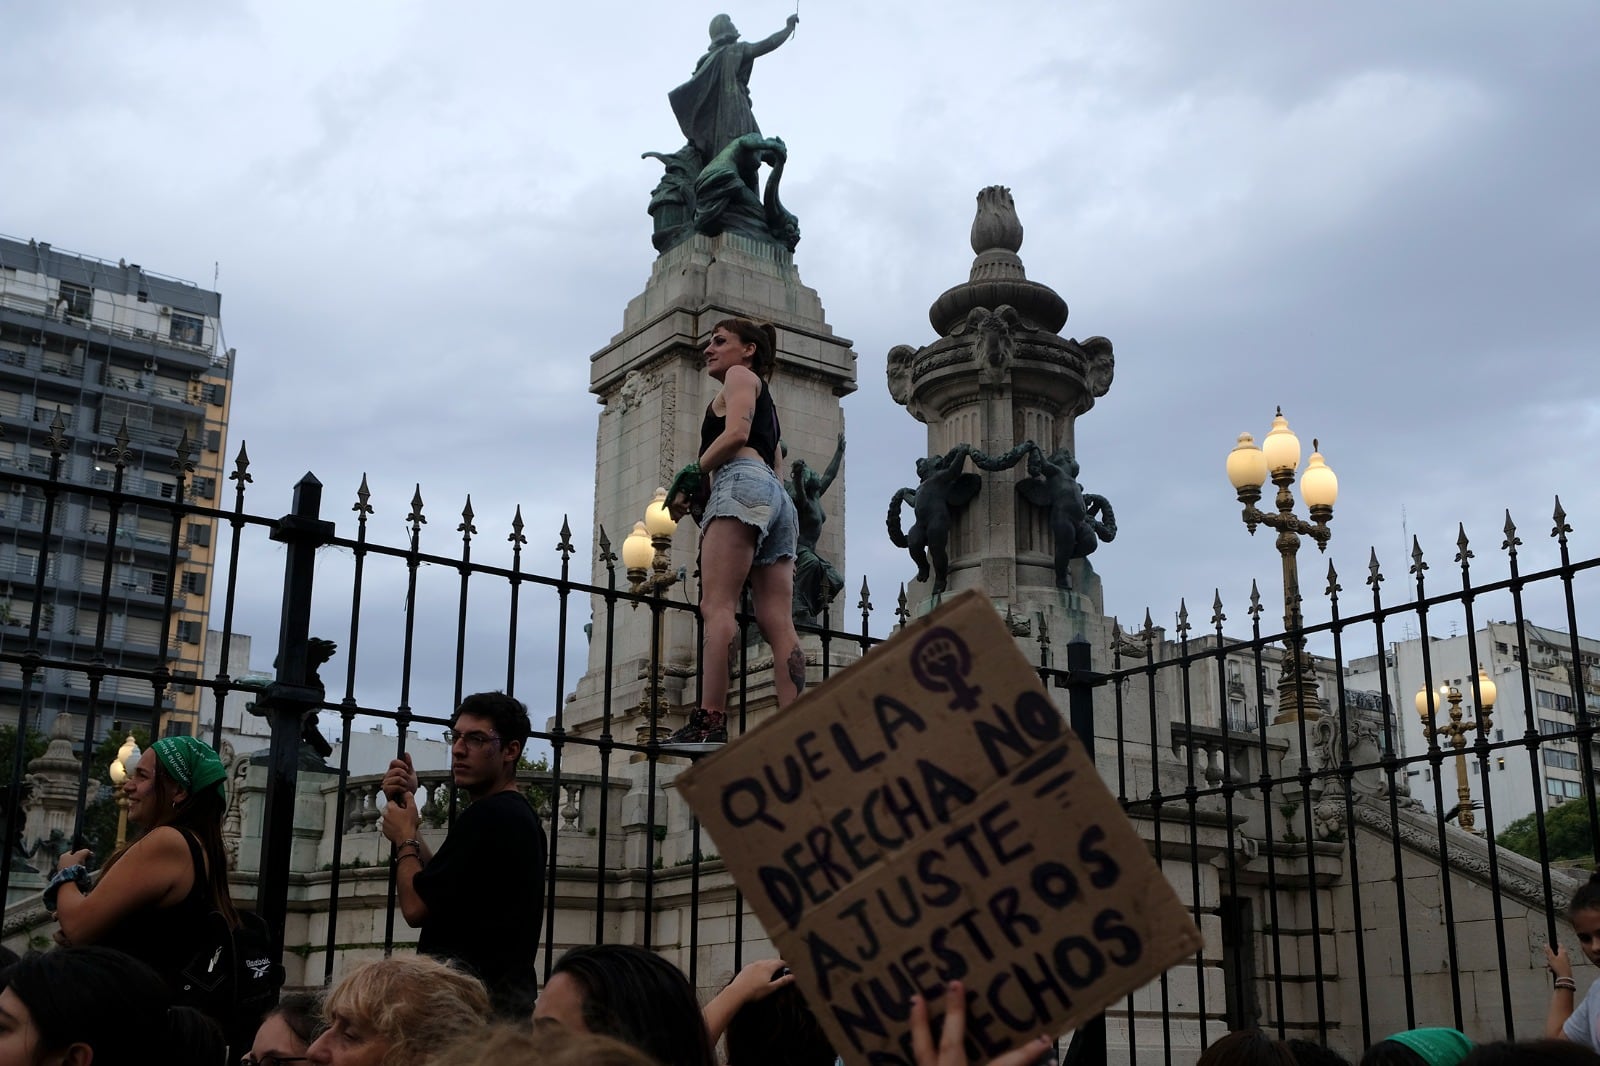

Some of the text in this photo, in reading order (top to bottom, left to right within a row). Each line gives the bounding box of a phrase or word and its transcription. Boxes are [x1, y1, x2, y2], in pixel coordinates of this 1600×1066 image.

[721, 694, 927, 832] QUE LA
[757, 690, 1062, 930] DERECHA NO
[804, 801, 1035, 998] AJUSTE
[828, 824, 1121, 1056] NUESTROS
[864, 908, 1143, 1066] ECHOS
